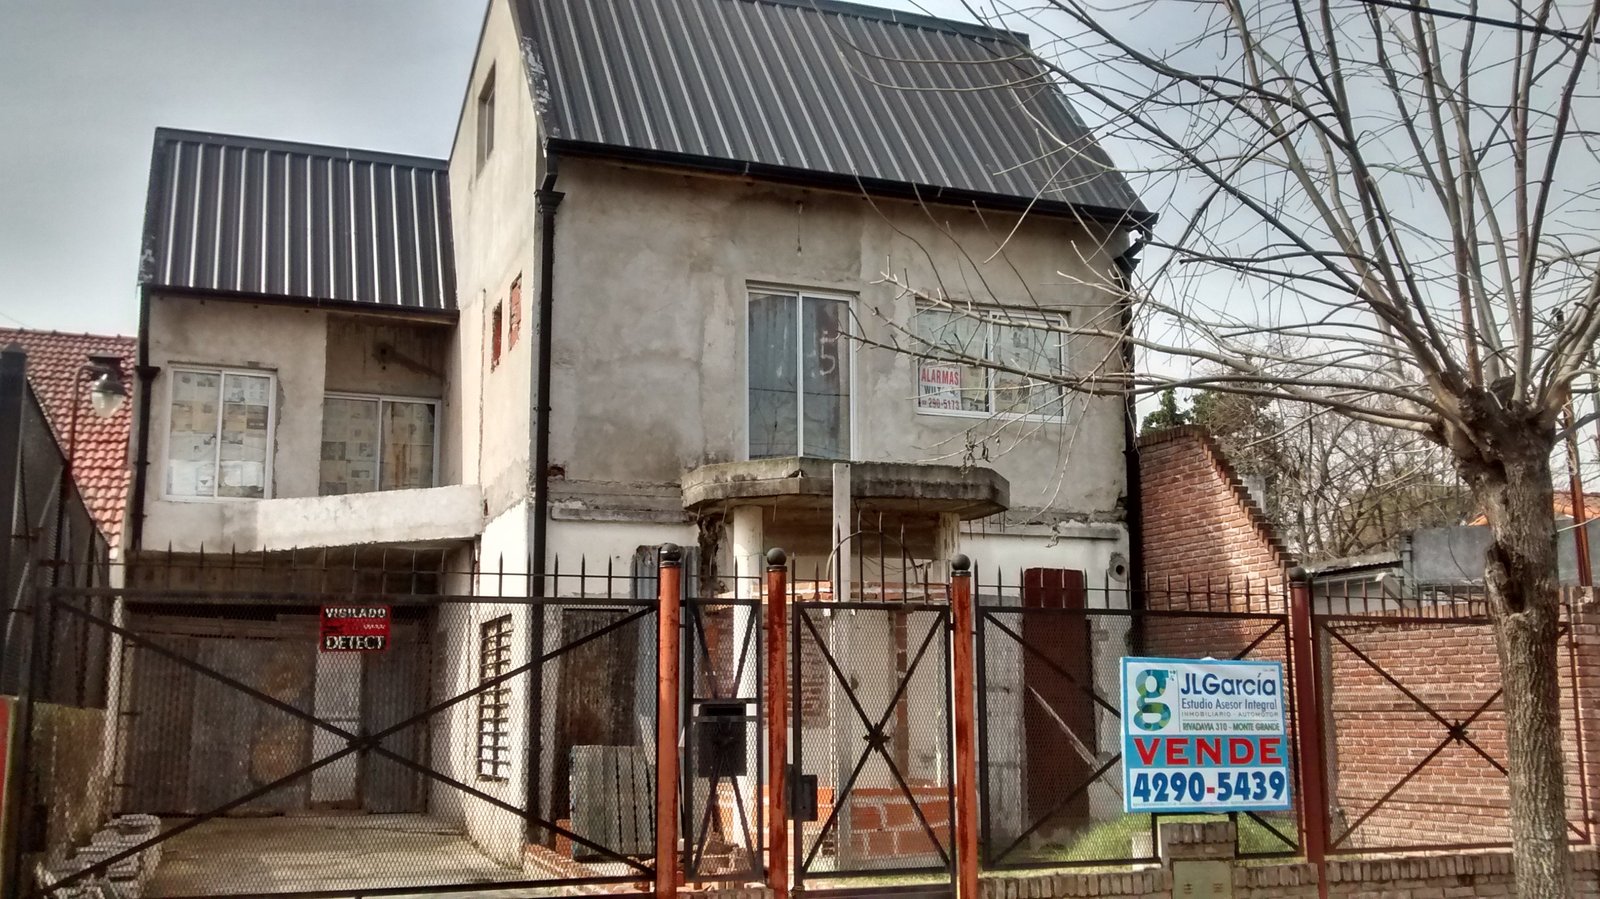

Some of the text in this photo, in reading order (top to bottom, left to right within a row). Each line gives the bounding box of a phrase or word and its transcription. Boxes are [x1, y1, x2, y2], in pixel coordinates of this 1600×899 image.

[921, 367, 959, 386] ALARMAS
[325, 608, 386, 618] VIGILADO
[326, 635, 385, 649] DETECT
[1181, 698, 1278, 713] Estudio Asesor Integral
[1182, 722, 1215, 732] RIVADAVIA
[1215, 722, 1228, 732] 310
[1232, 722, 1254, 732] MONTE
[1255, 722, 1280, 732] GRANDE
[1133, 737, 1283, 767] VENDE
[1132, 770, 1286, 803] 4290-5439
